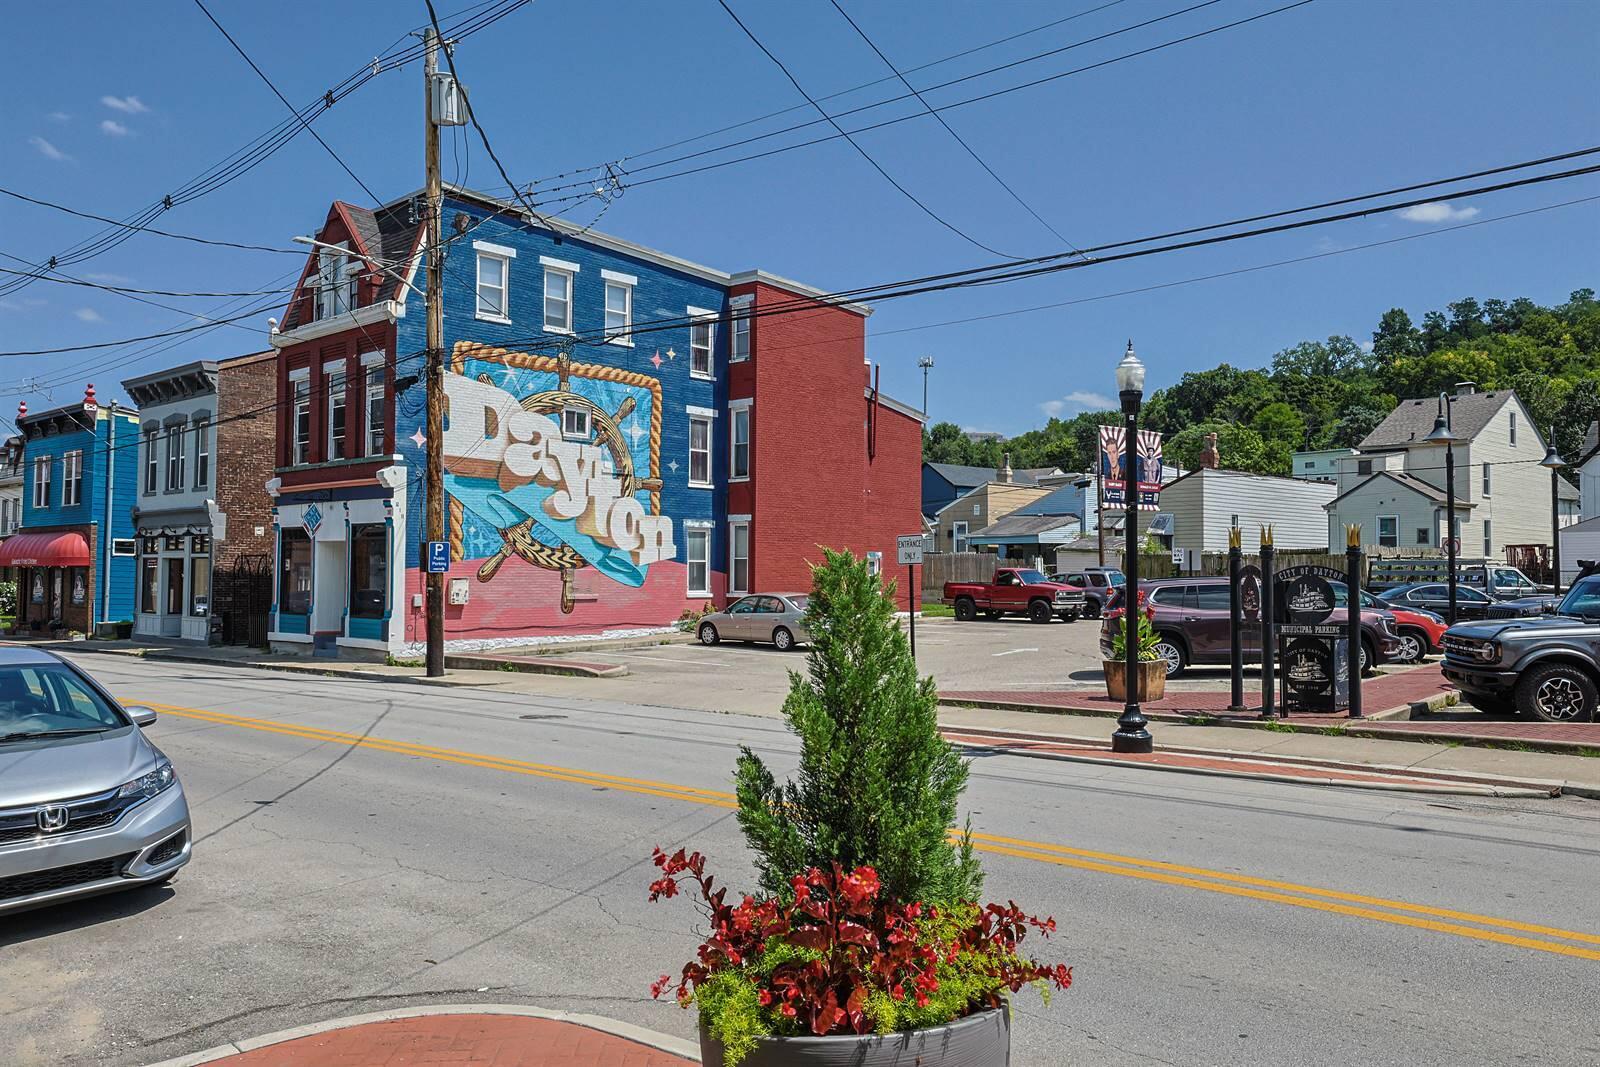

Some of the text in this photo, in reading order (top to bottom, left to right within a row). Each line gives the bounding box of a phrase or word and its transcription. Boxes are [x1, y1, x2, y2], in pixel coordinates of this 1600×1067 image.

[442, 369, 677, 566] Dayton
[898, 540, 922, 548] ENTRANCE
[435, 544, 444, 556] P
[904, 551, 916, 560] ONLY
[1278, 567, 1344, 580] CITY OF DAYTON
[1281, 625, 1340, 634] MUNICIPAL PARKING
